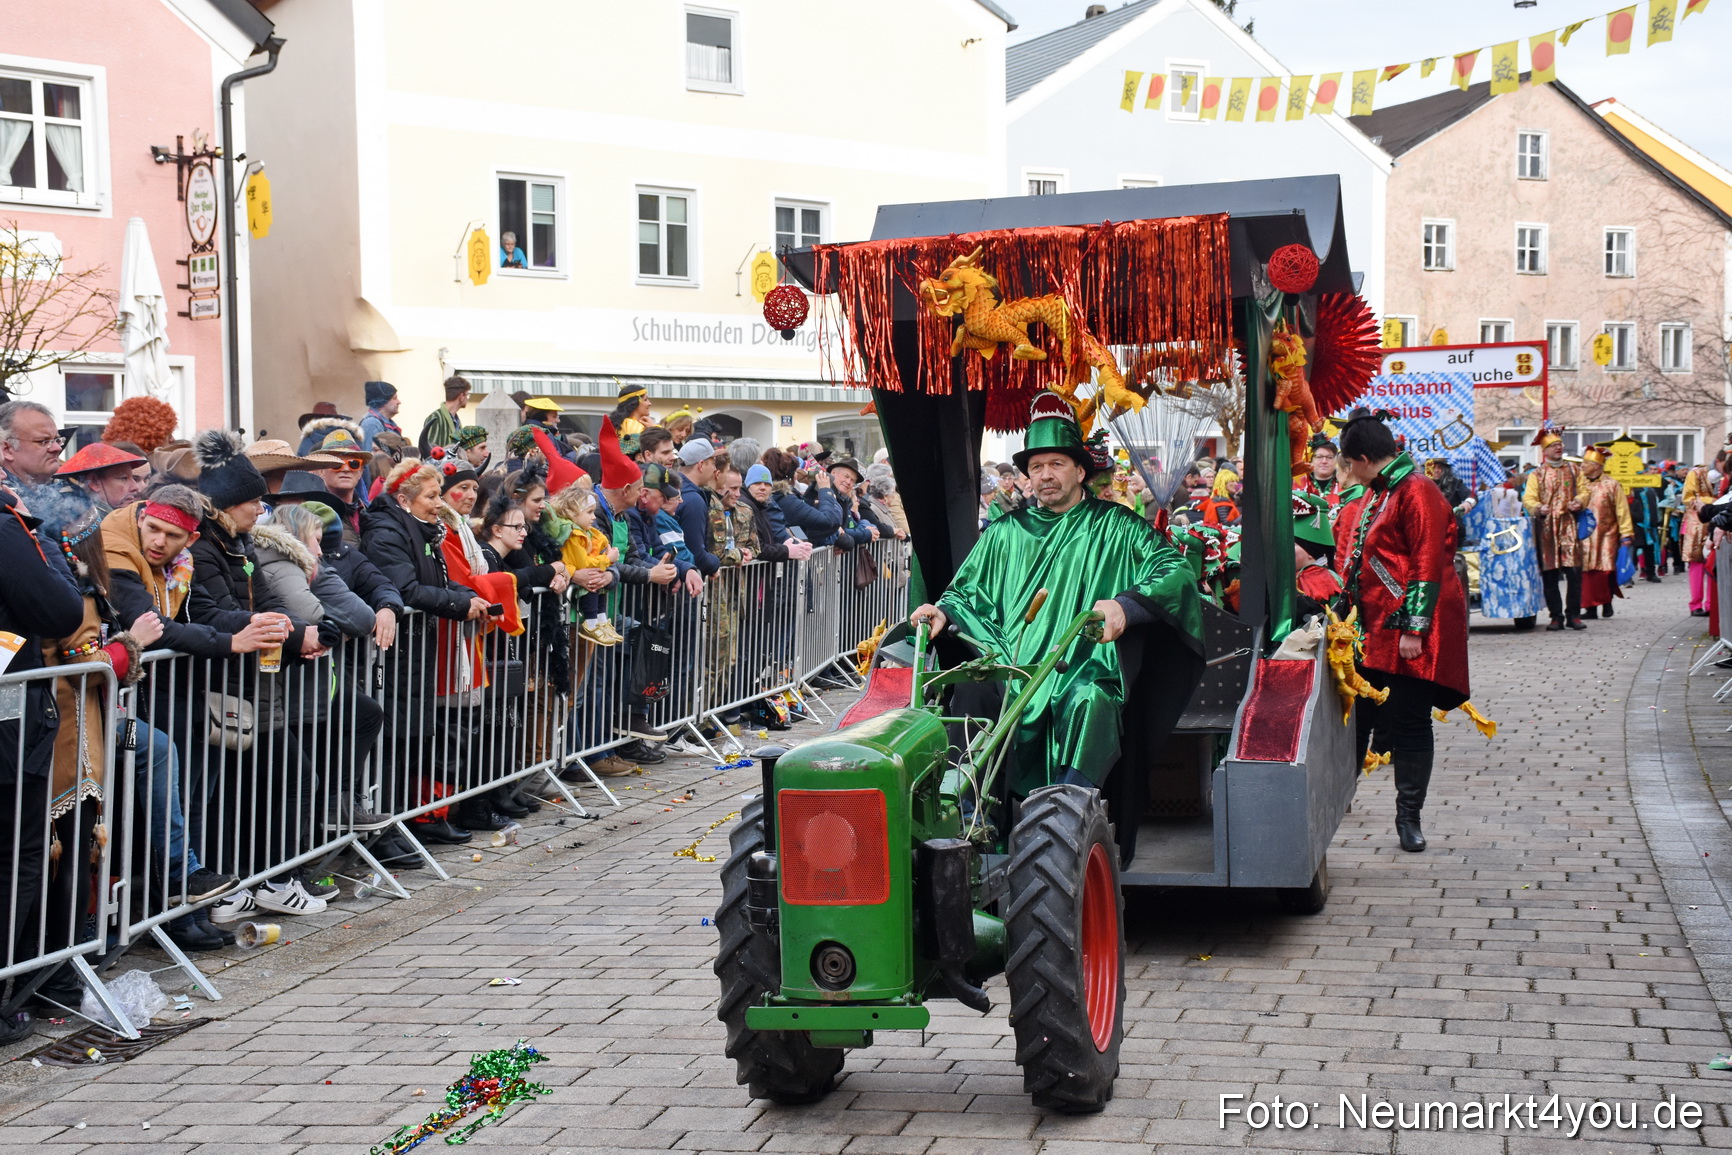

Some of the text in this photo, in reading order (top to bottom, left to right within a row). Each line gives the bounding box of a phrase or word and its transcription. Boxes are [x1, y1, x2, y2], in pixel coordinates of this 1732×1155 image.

[632, 316, 743, 345] Schuhmoden
[1447, 350, 1475, 364] auf
[1472, 368, 1513, 382] uche
[1363, 381, 1452, 397] nstmann
[1408, 435, 1438, 452] rat
